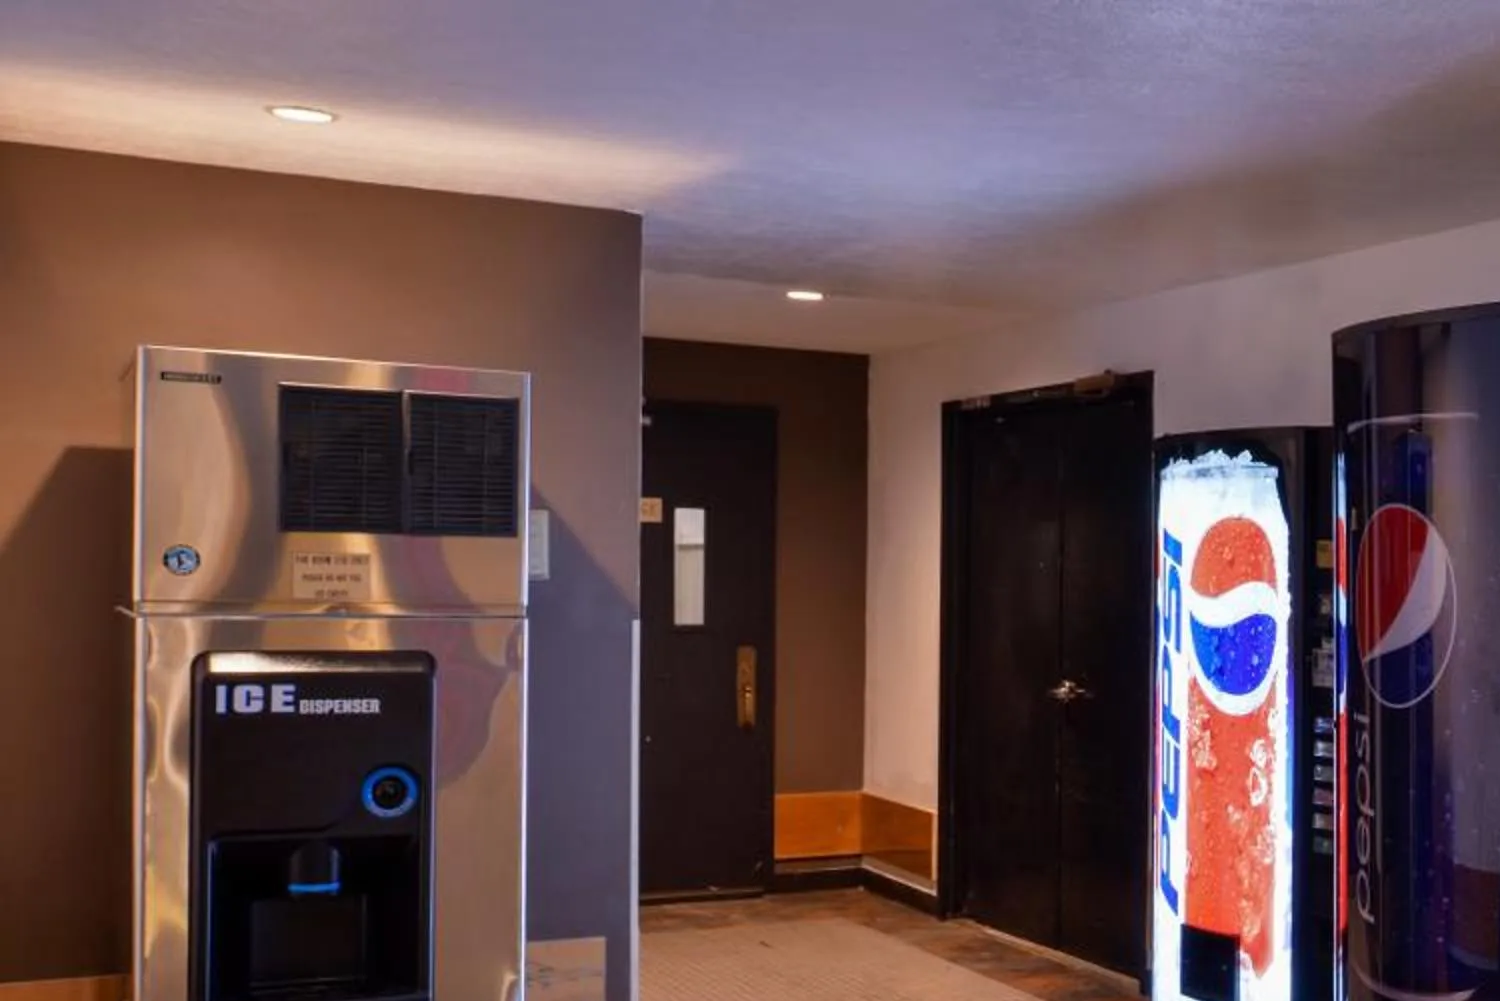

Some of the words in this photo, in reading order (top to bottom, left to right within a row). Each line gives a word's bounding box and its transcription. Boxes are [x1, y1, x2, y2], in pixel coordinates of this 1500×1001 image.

[215, 684, 296, 713] ICE
[299, 697, 381, 714] DISPENSER
[1160, 528, 1183, 917] PEPSI
